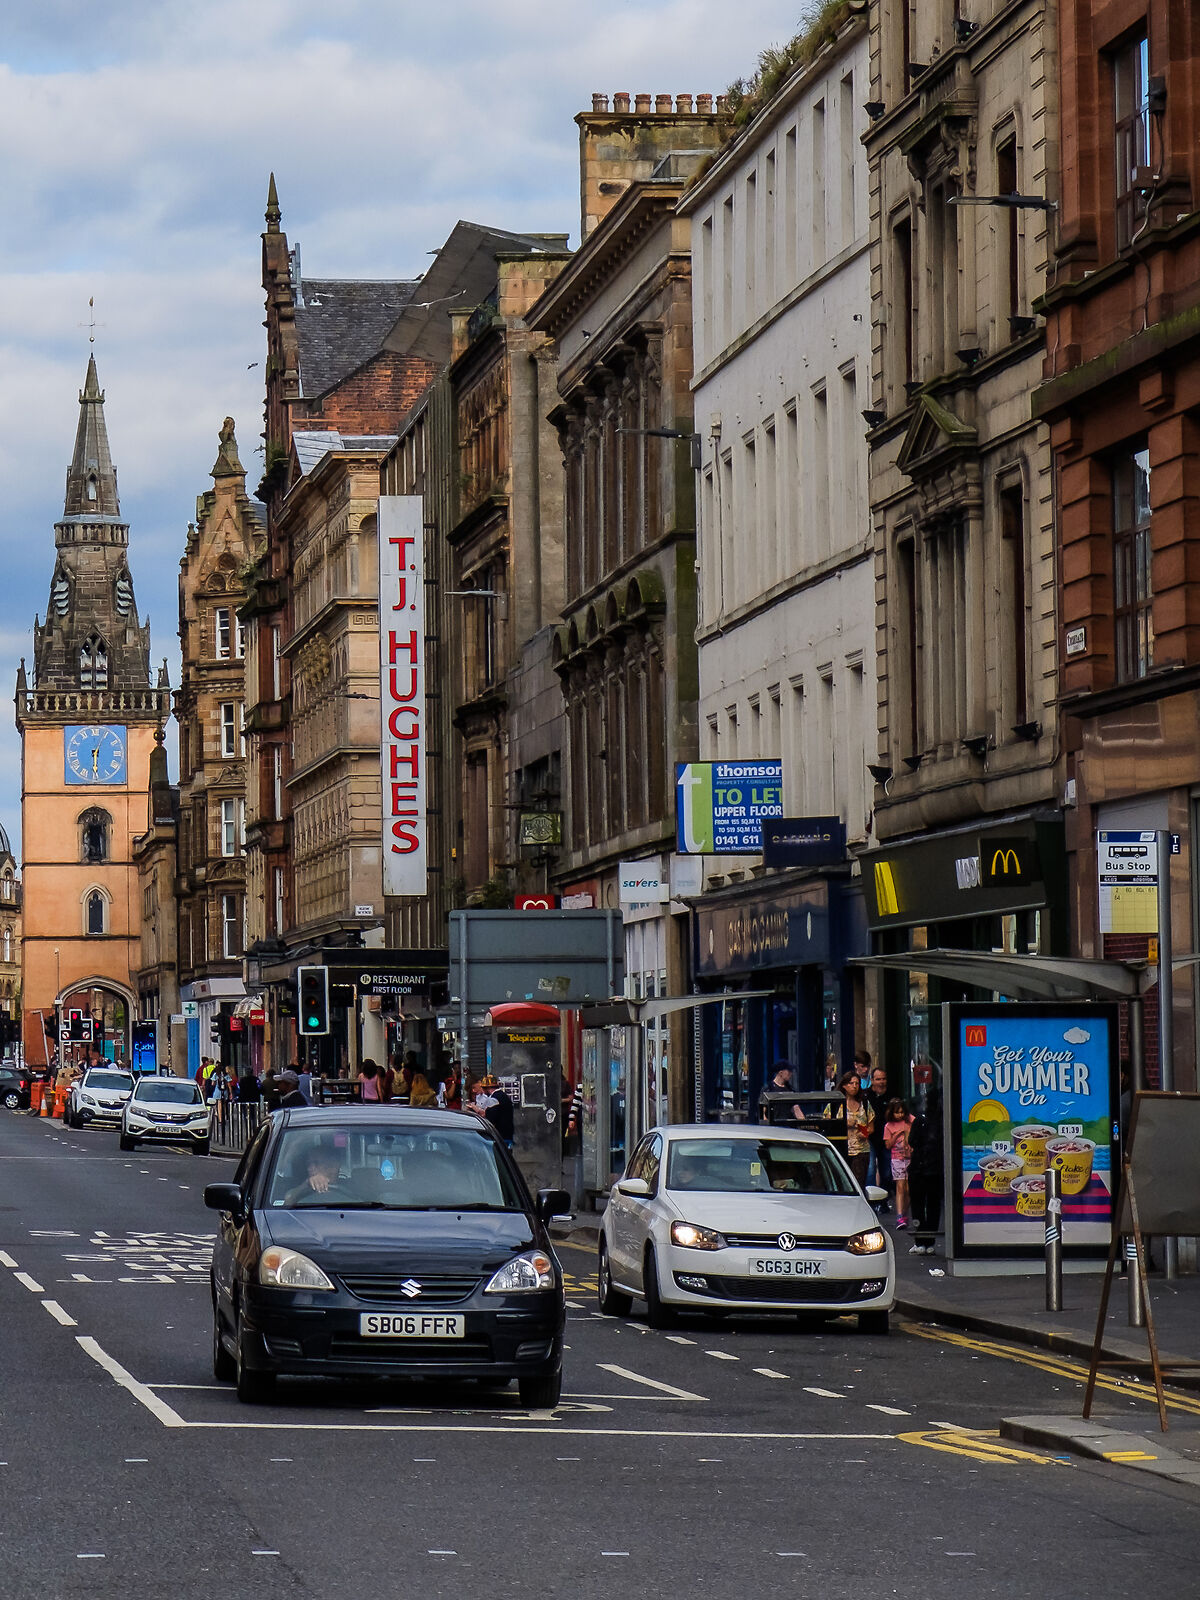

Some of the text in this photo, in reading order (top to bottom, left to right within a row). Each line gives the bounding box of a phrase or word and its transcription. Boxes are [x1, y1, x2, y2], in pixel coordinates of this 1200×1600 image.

[388, 630, 420, 855] HUGHES
[714, 787, 783, 805] TO LET
[714, 807, 746, 817] UPPER
[715, 835, 759, 845] 0141 611
[1105, 862, 1151, 871] Bus Stop
[622, 879, 658, 888] savers
[372, 975, 426, 984] RESTAURANT
[507, 1033, 546, 1043] Telephone
[993, 1045, 1074, 1067] Get Your
[978, 1062, 1090, 1096] SUMMER
[1019, 1088, 1047, 1106] On
[1061, 1126, 1080, 1134] £1.39
[994, 1143, 1008, 1152] 99p
[756, 1260, 821, 1274] SG63 GHX
[367, 1316, 457, 1335] SB06 FFR
